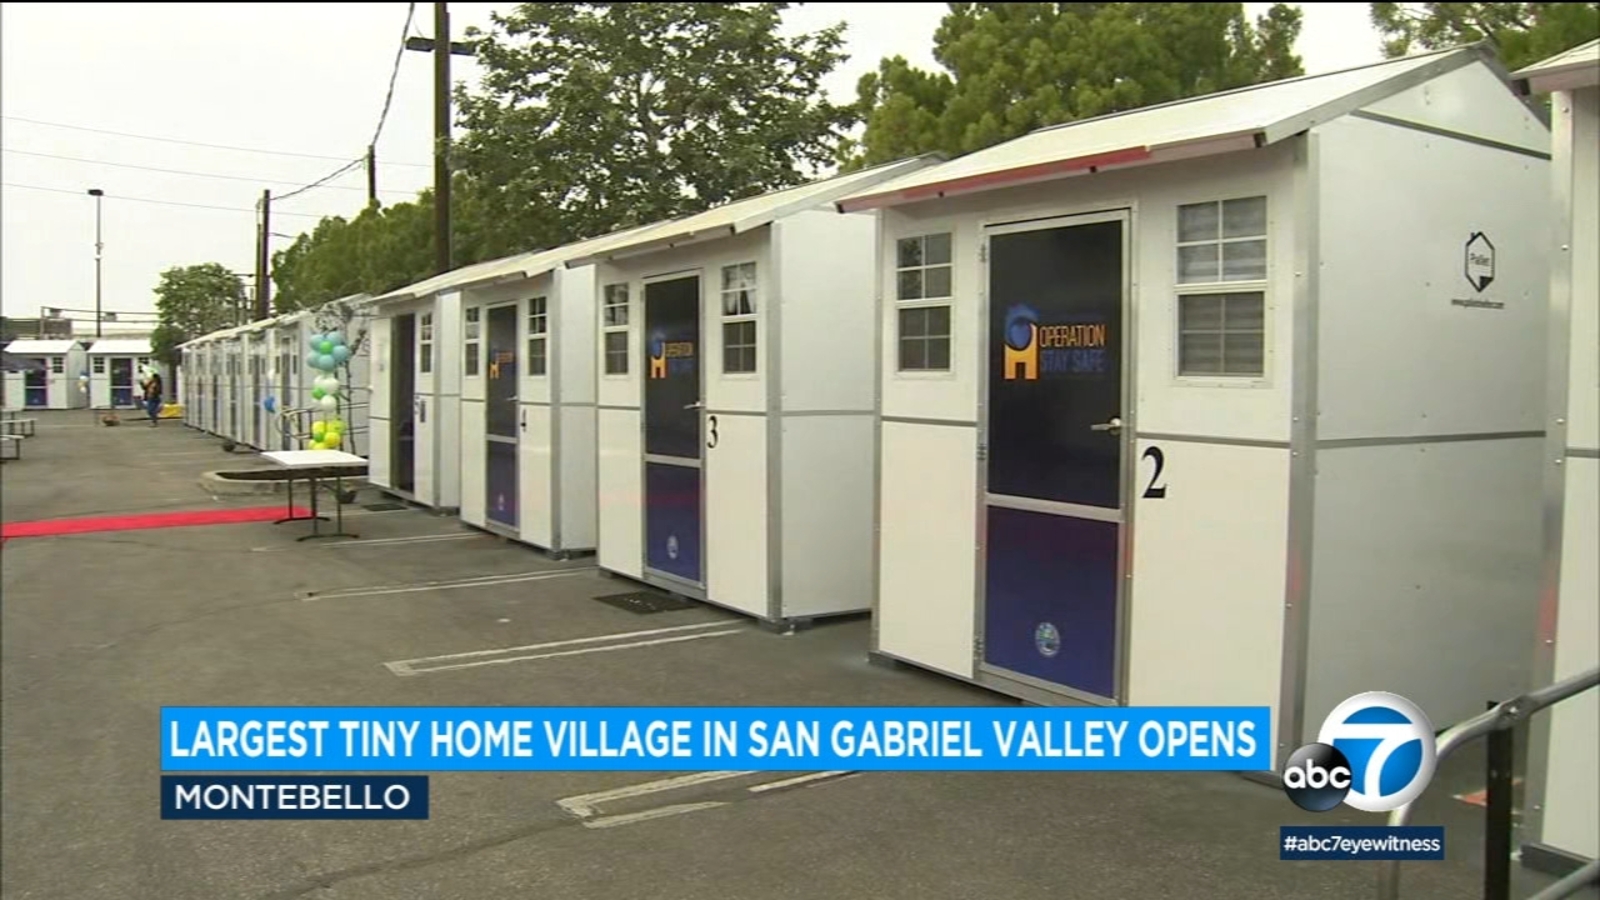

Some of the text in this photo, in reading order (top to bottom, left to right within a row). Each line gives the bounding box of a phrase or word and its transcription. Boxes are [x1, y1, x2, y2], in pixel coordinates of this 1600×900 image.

[1039, 324, 1107, 348] OPERATION
[706, 415, 719, 449] 3
[1141, 445, 1168, 499] 2
